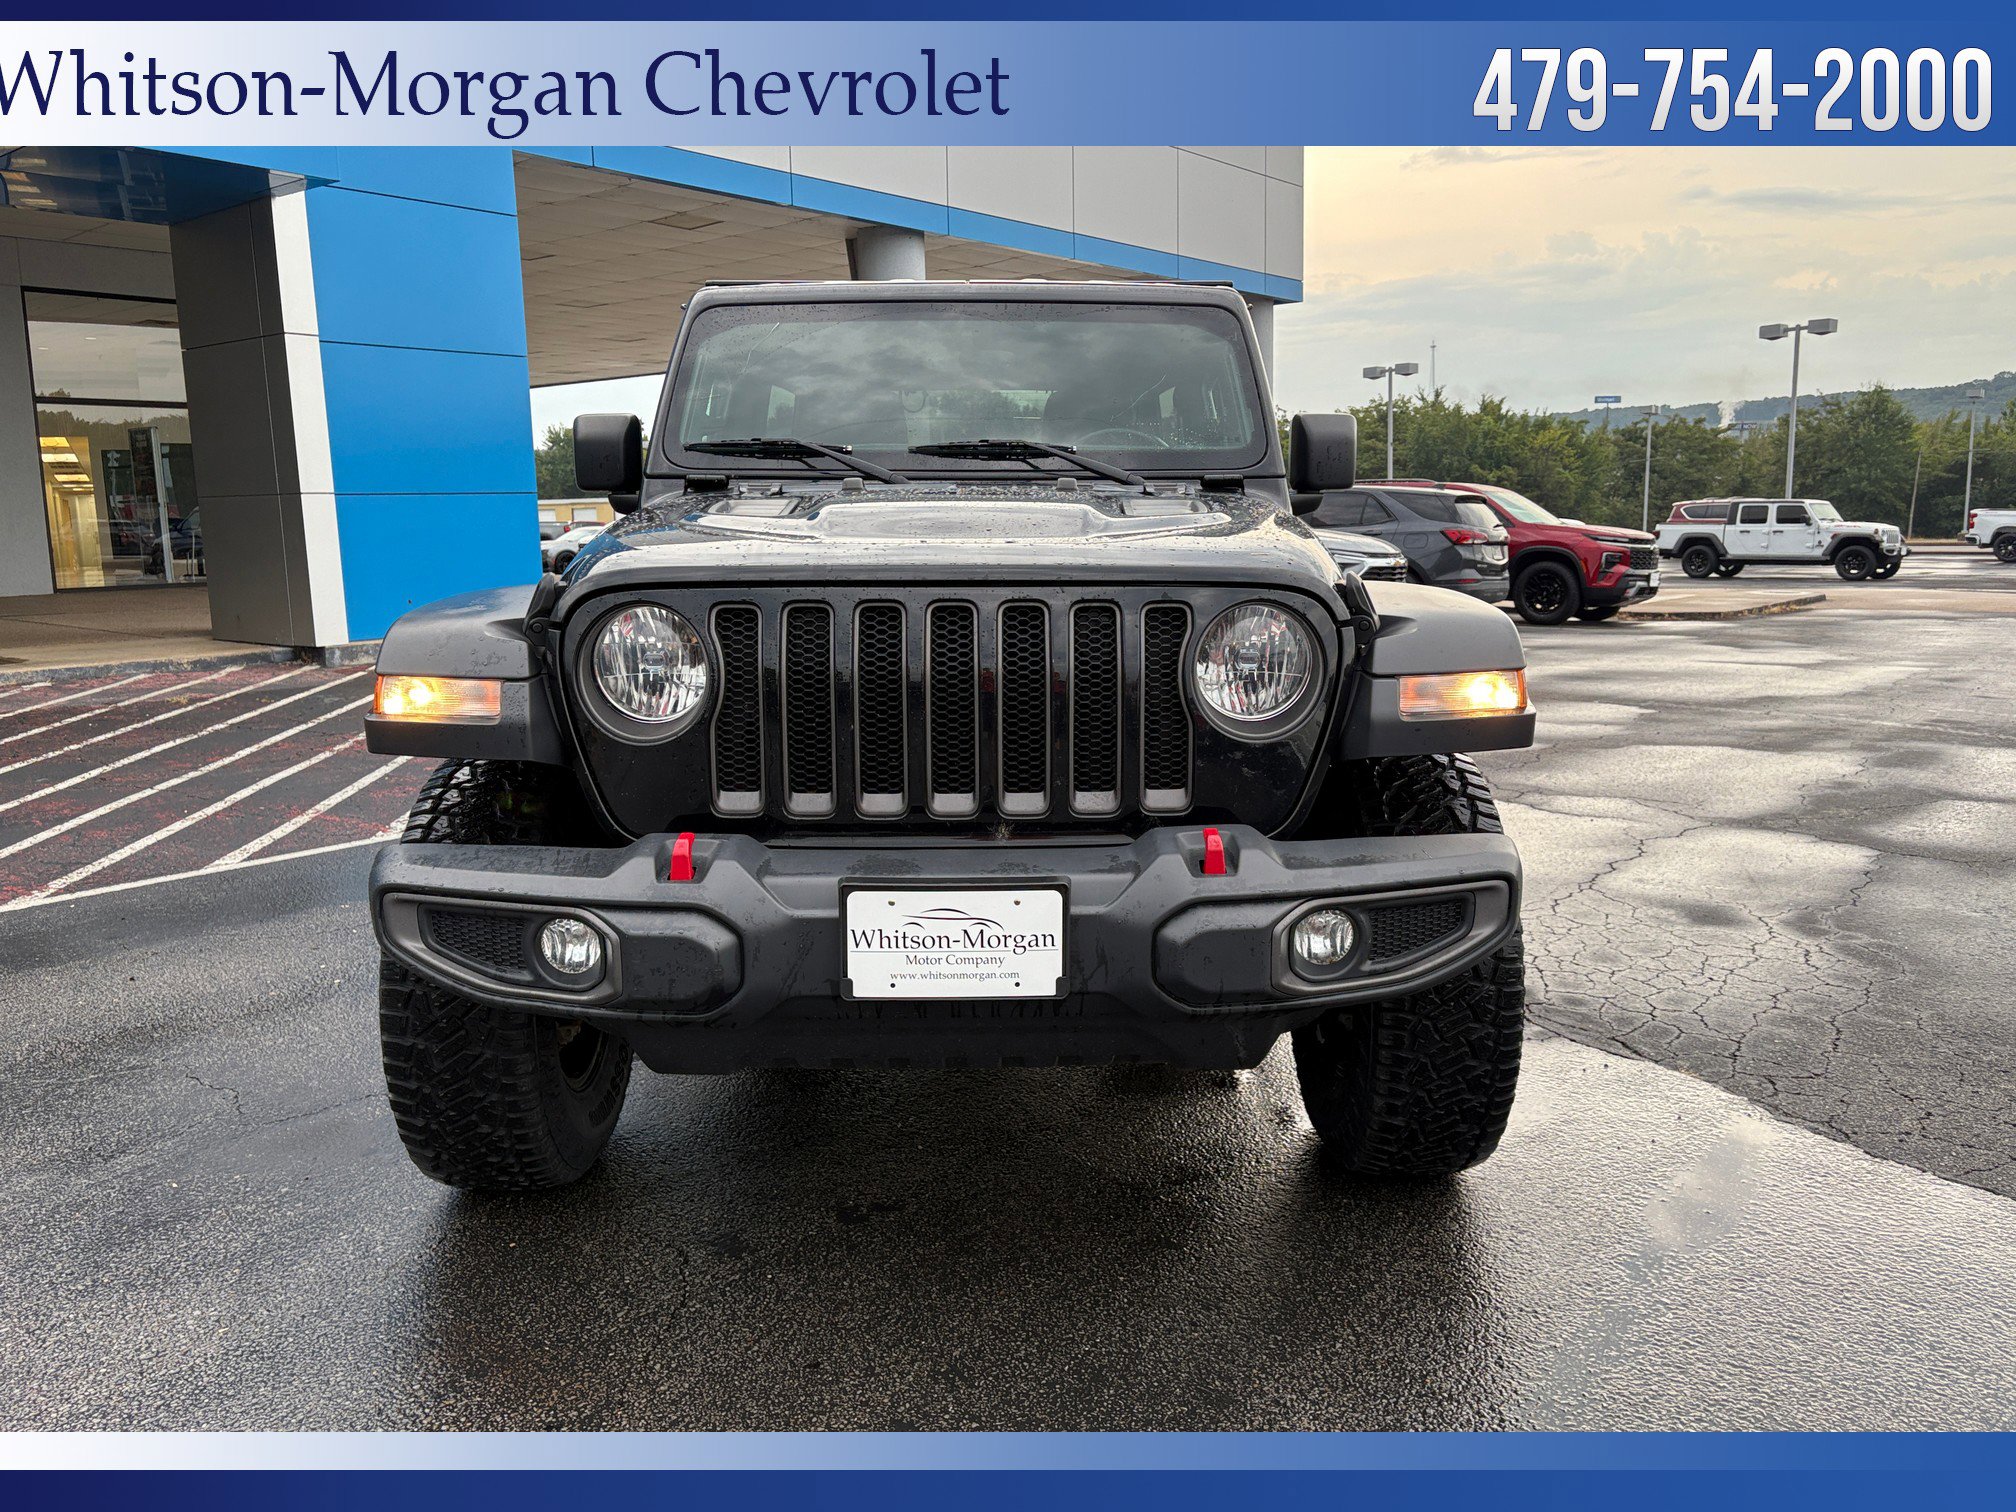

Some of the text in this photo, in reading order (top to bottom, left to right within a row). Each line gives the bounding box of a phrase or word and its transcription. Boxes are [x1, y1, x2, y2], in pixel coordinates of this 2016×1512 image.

[850, 928, 1057, 955] Whitson-Morgan
[905, 954, 1006, 968] Motor Company
[890, 970, 1020, 982] www.whitsonmorgan.com
